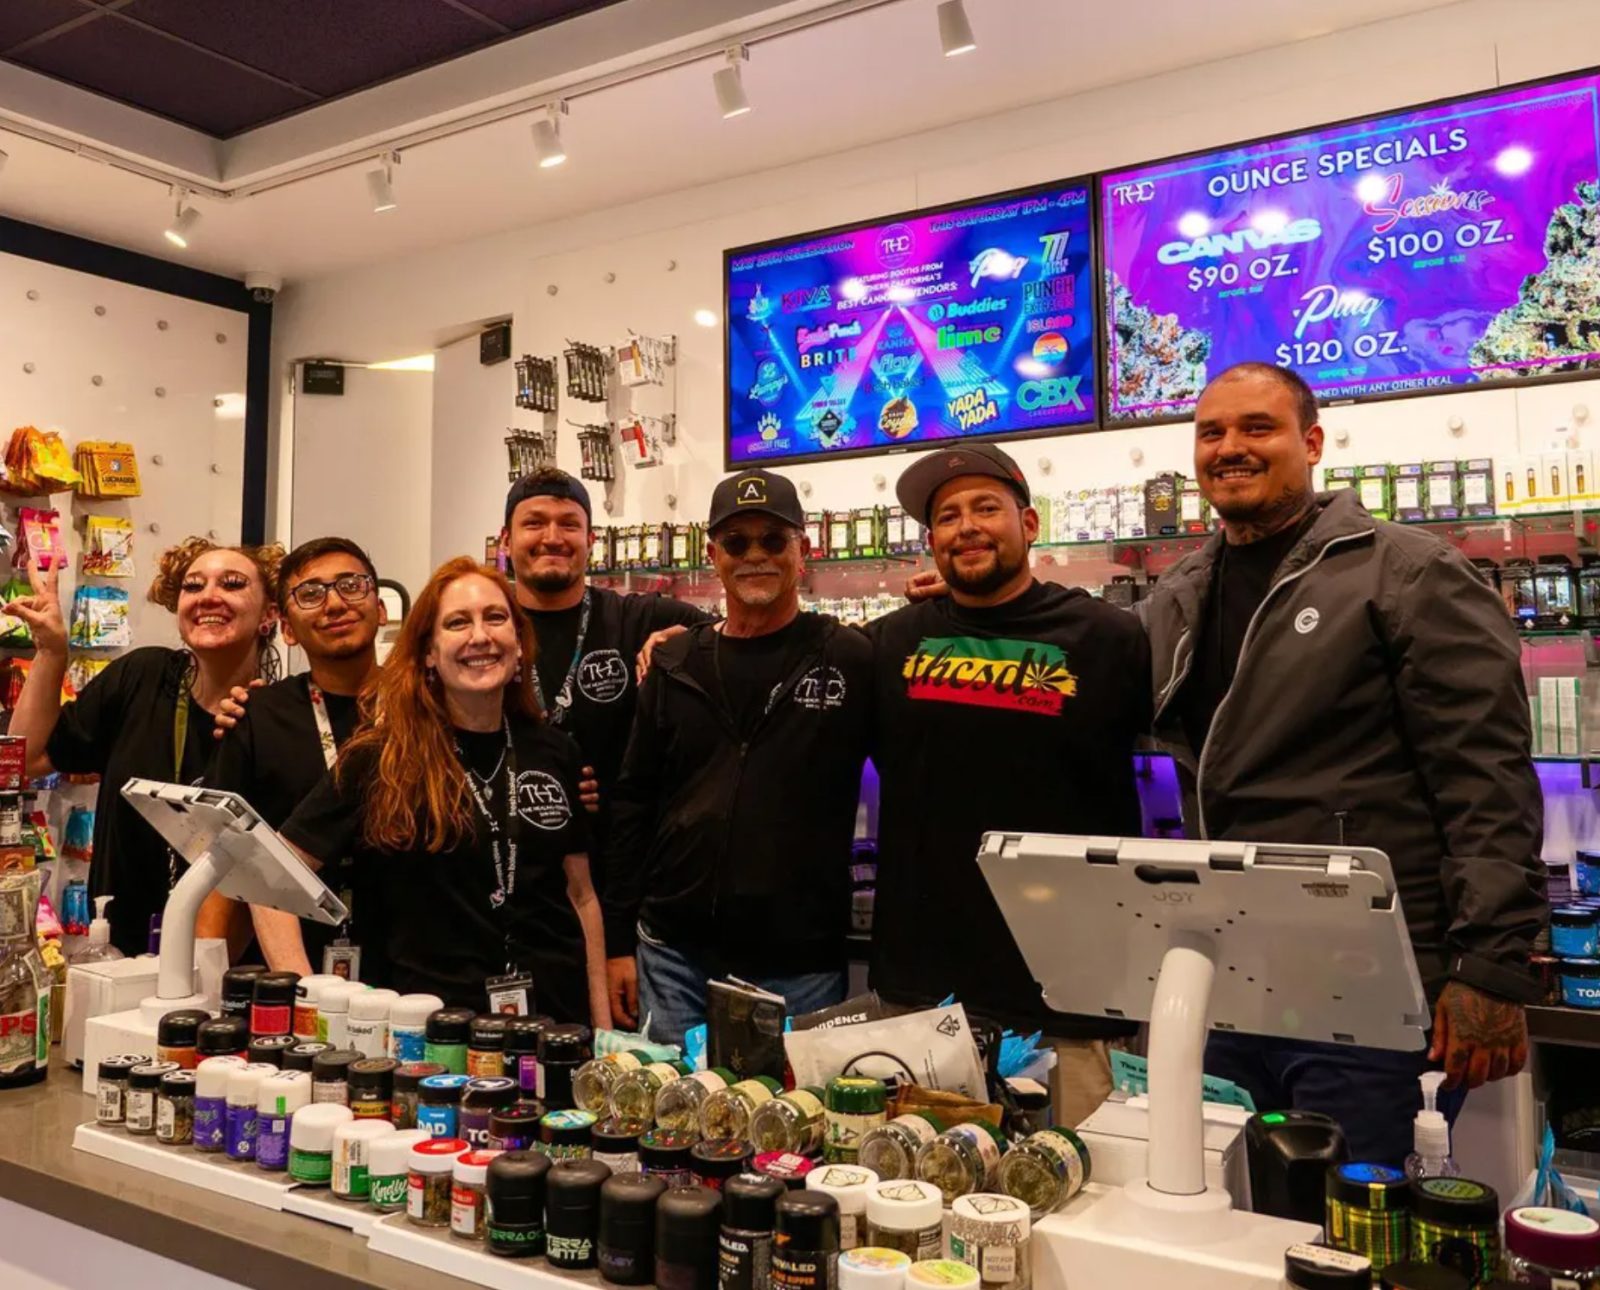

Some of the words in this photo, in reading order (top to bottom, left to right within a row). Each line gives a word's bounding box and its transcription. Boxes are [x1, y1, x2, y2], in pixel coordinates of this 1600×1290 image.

[1208, 159, 1308, 197] OUNCE
[1318, 129, 1468, 177] SPECIALS
[1113, 181, 1155, 205] THC
[955, 204, 1019, 227] SATURDAY
[1056, 190, 1086, 208] 4PM
[1157, 218, 1322, 265] CANVAS
[1367, 229, 1444, 263] $100
[1455, 219, 1514, 248] OZ.
[890, 266, 919, 278] BOOTHS
[920, 261, 943, 272] FROM
[1188, 263, 1239, 292] $90
[1249, 253, 1299, 280] OZ.
[1024, 278, 1073, 300] PUNCH
[836, 298, 859, 311] BEST
[947, 297, 1007, 318] Buddies
[938, 324, 1001, 350] lime
[1275, 339, 1343, 369] $120
[1353, 331, 1408, 358] OZ.
[1016, 375, 1086, 411] CBX
[1312, 386, 1339, 398] INED
[1340, 384, 1366, 397] WITH
[1368, 381, 1389, 393] ANY
[1391, 377, 1425, 391] OTHER
[1426, 375, 1452, 387] DEAL
[948, 388, 985, 417] YADA
[958, 400, 996, 430] YADA
[744, 483, 759, 498] A
[811, 1012, 868, 1030] VIDENCE
[468, 1128, 490, 1143] TO
[546, 1233, 592, 1249] TERRA
